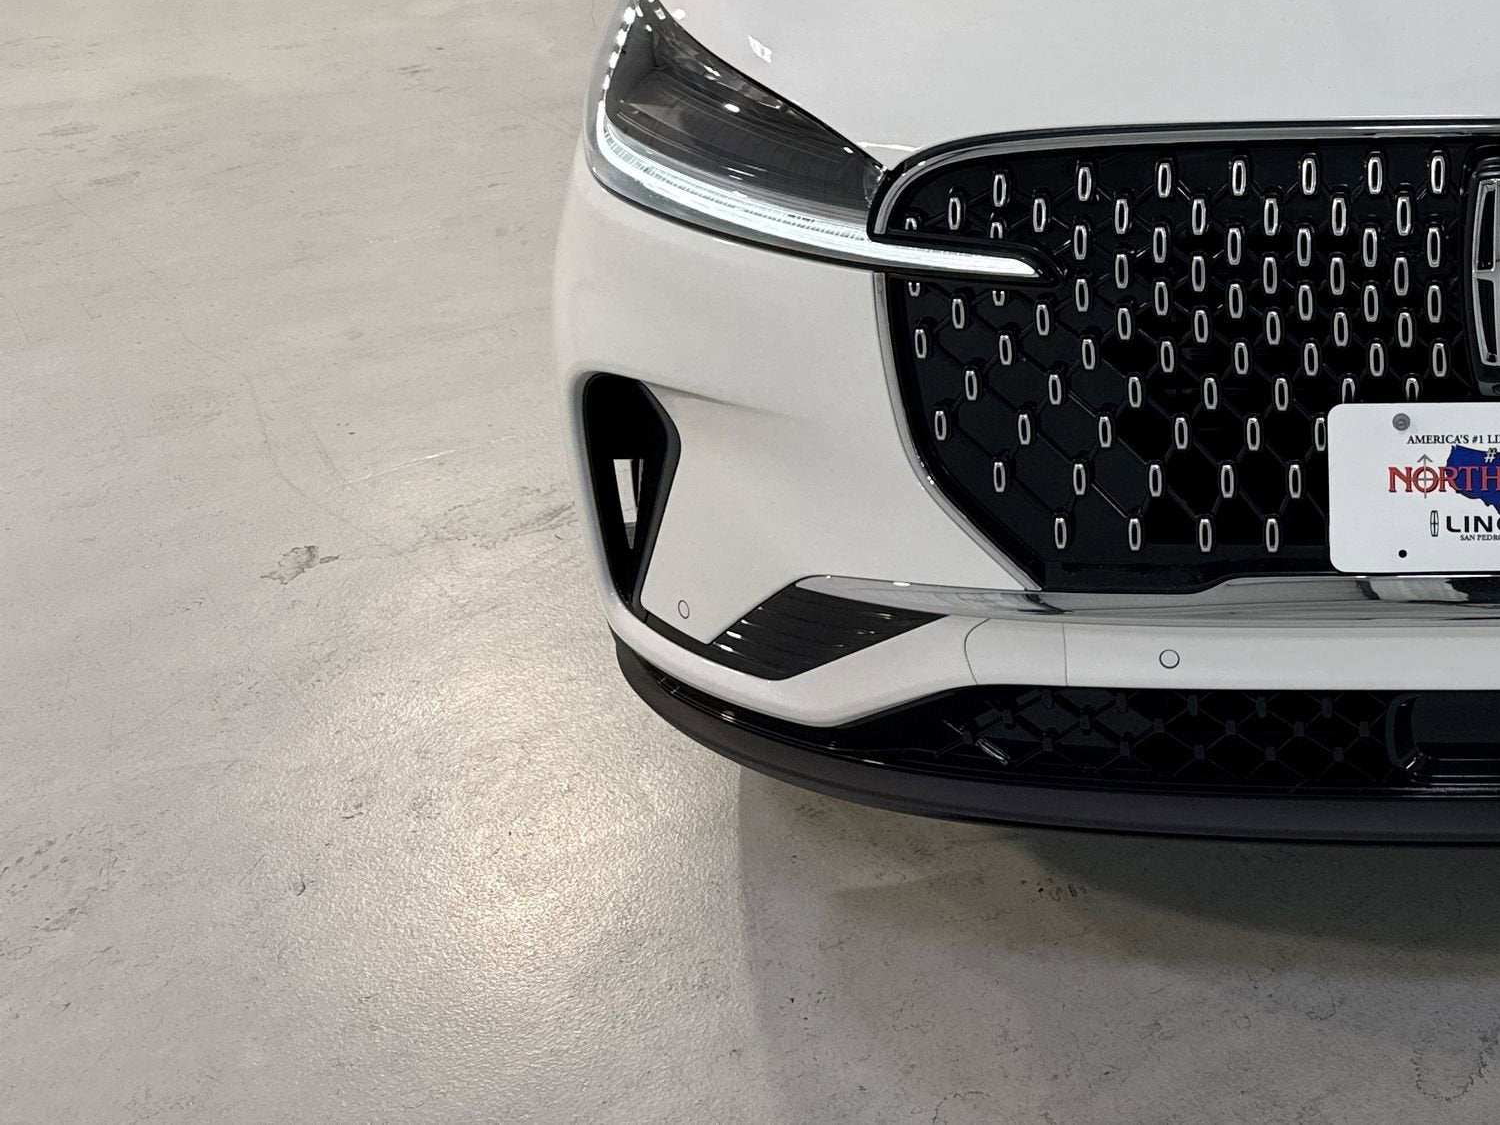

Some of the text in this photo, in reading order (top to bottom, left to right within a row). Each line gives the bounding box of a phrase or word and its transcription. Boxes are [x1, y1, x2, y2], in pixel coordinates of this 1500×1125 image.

[1406, 434, 1470, 445] AMERICA'S
[1471, 434, 1484, 444] #1
[1459, 533, 1476, 542] SAN
